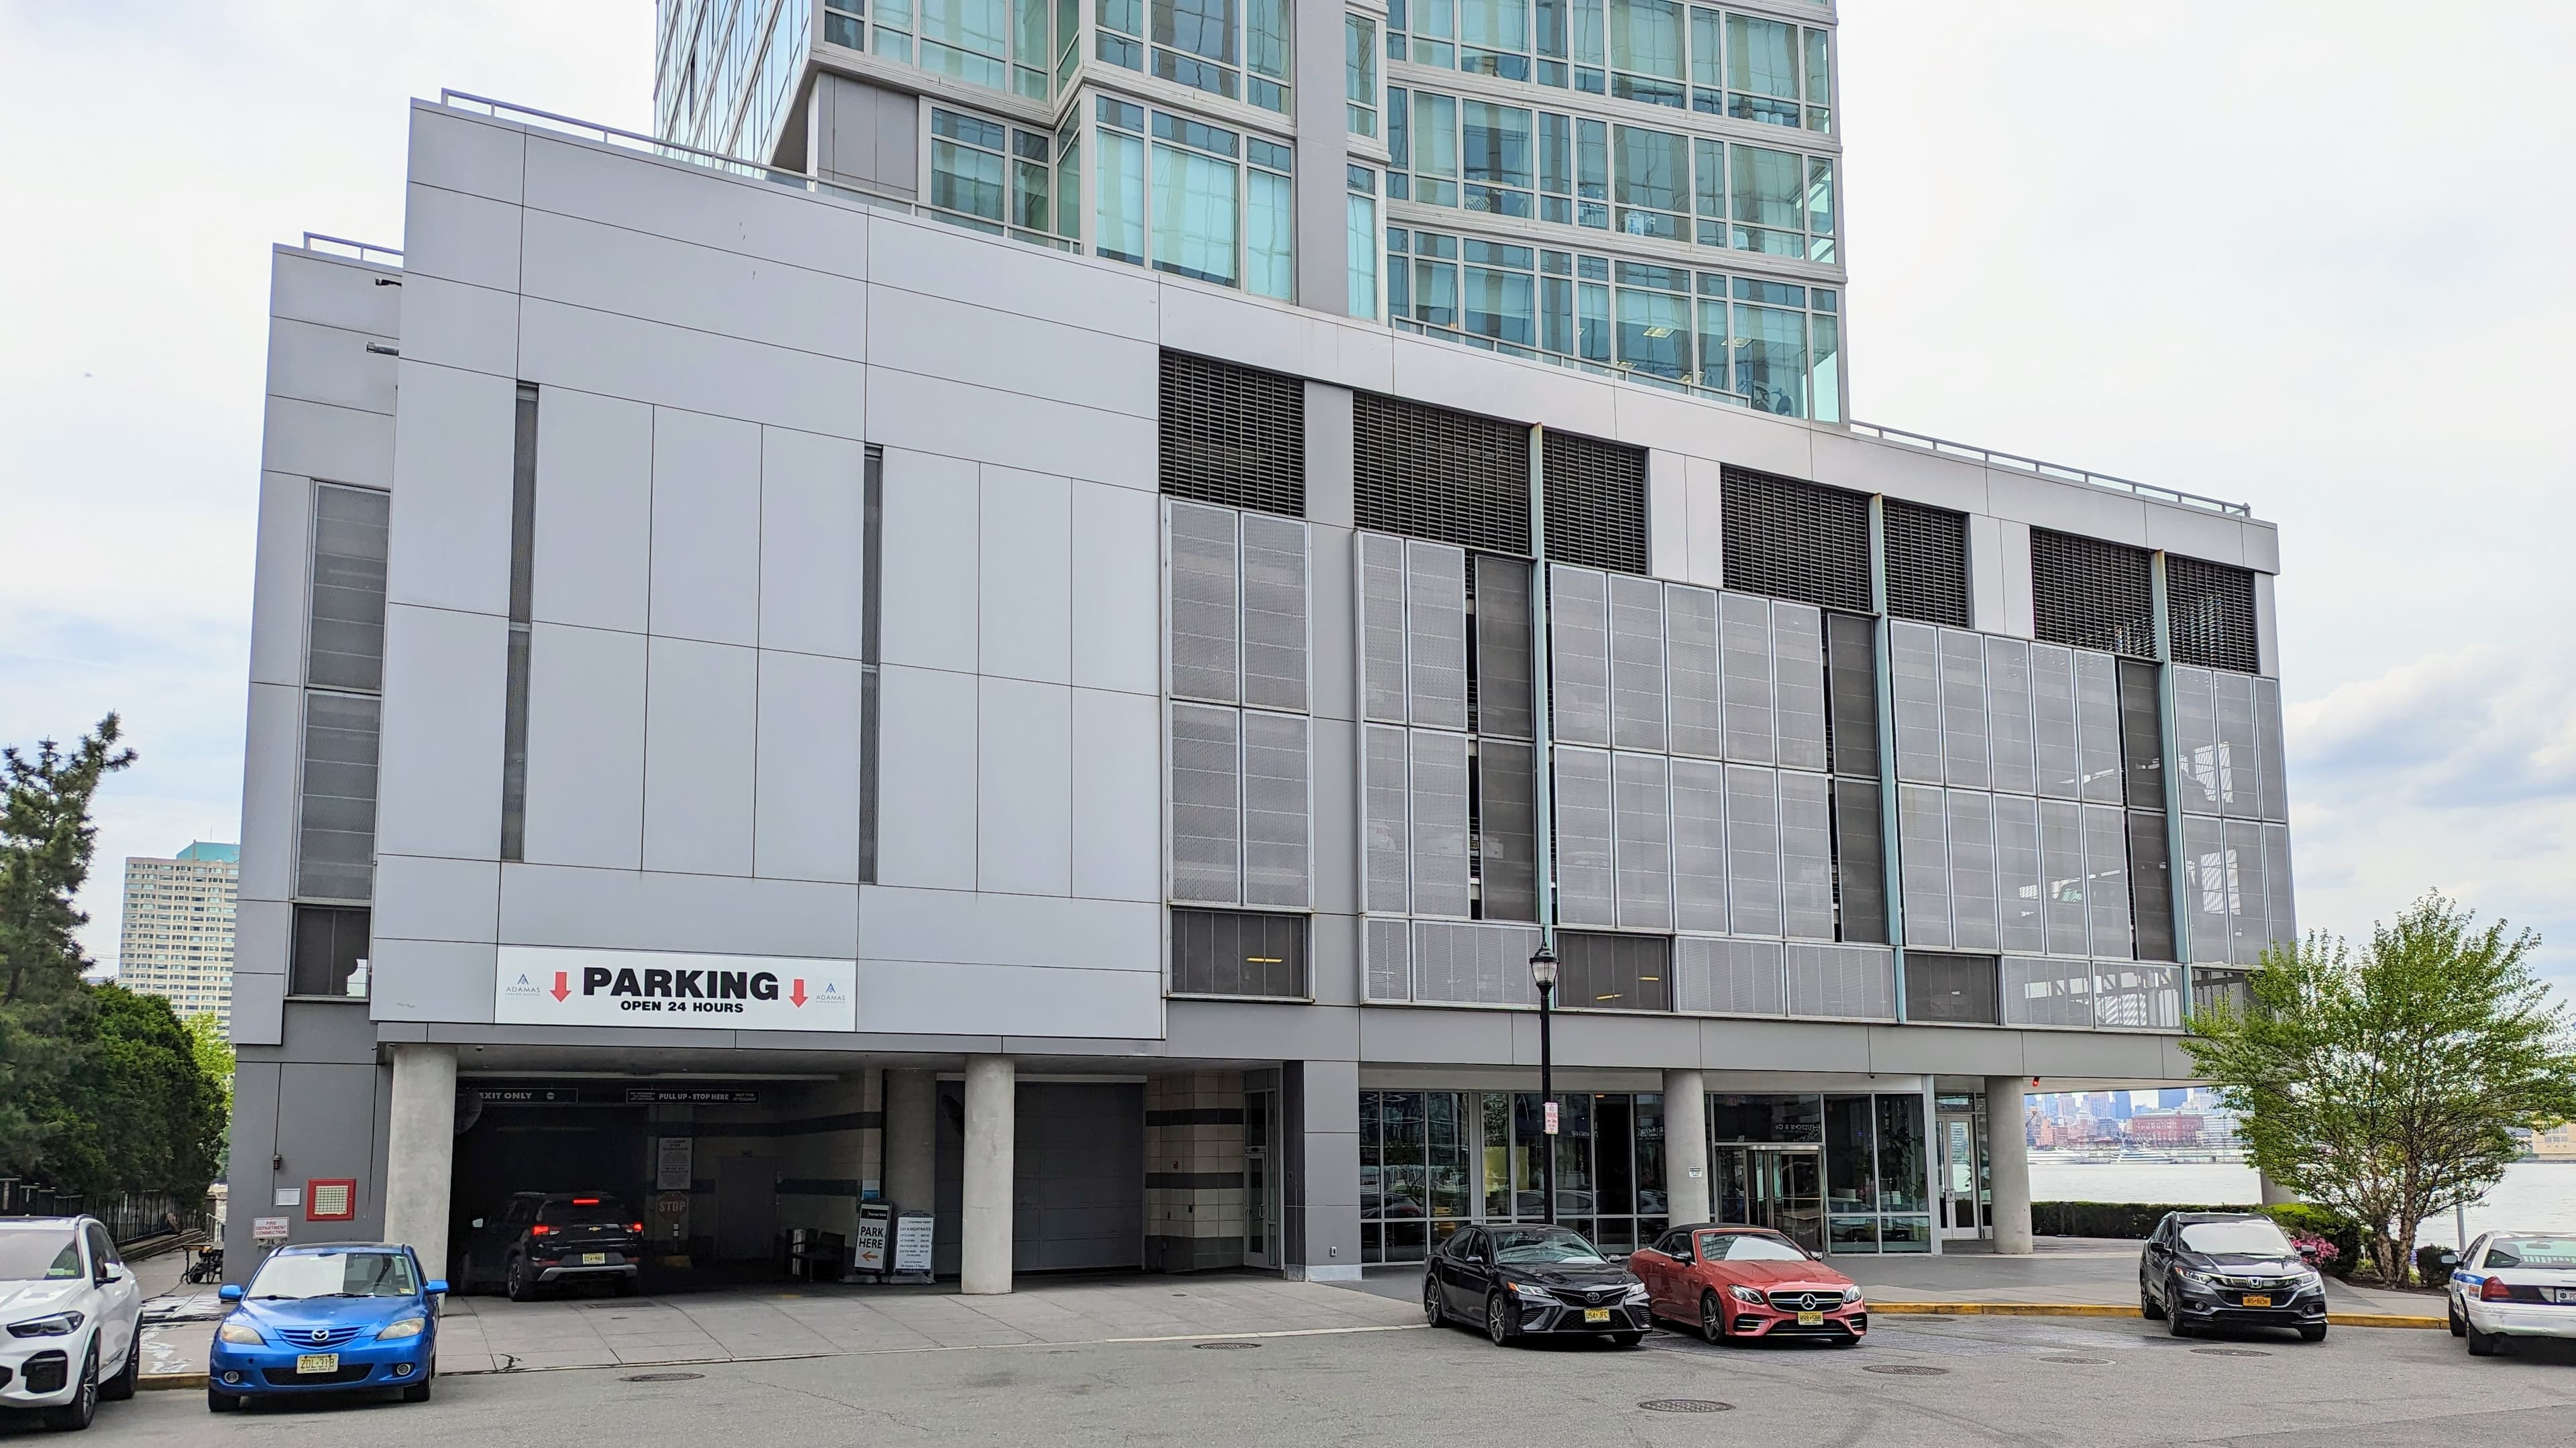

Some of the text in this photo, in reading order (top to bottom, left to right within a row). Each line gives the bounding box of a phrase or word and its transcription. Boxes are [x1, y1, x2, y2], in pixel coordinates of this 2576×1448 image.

[584, 967, 778, 1000] PARKING
[621, 1000, 743, 1013] OPEN 24 HOURS
[659, 1201, 686, 1212] STOP
[861, 1226, 883, 1237] PARK
[859, 1238, 883, 1249] HERE
